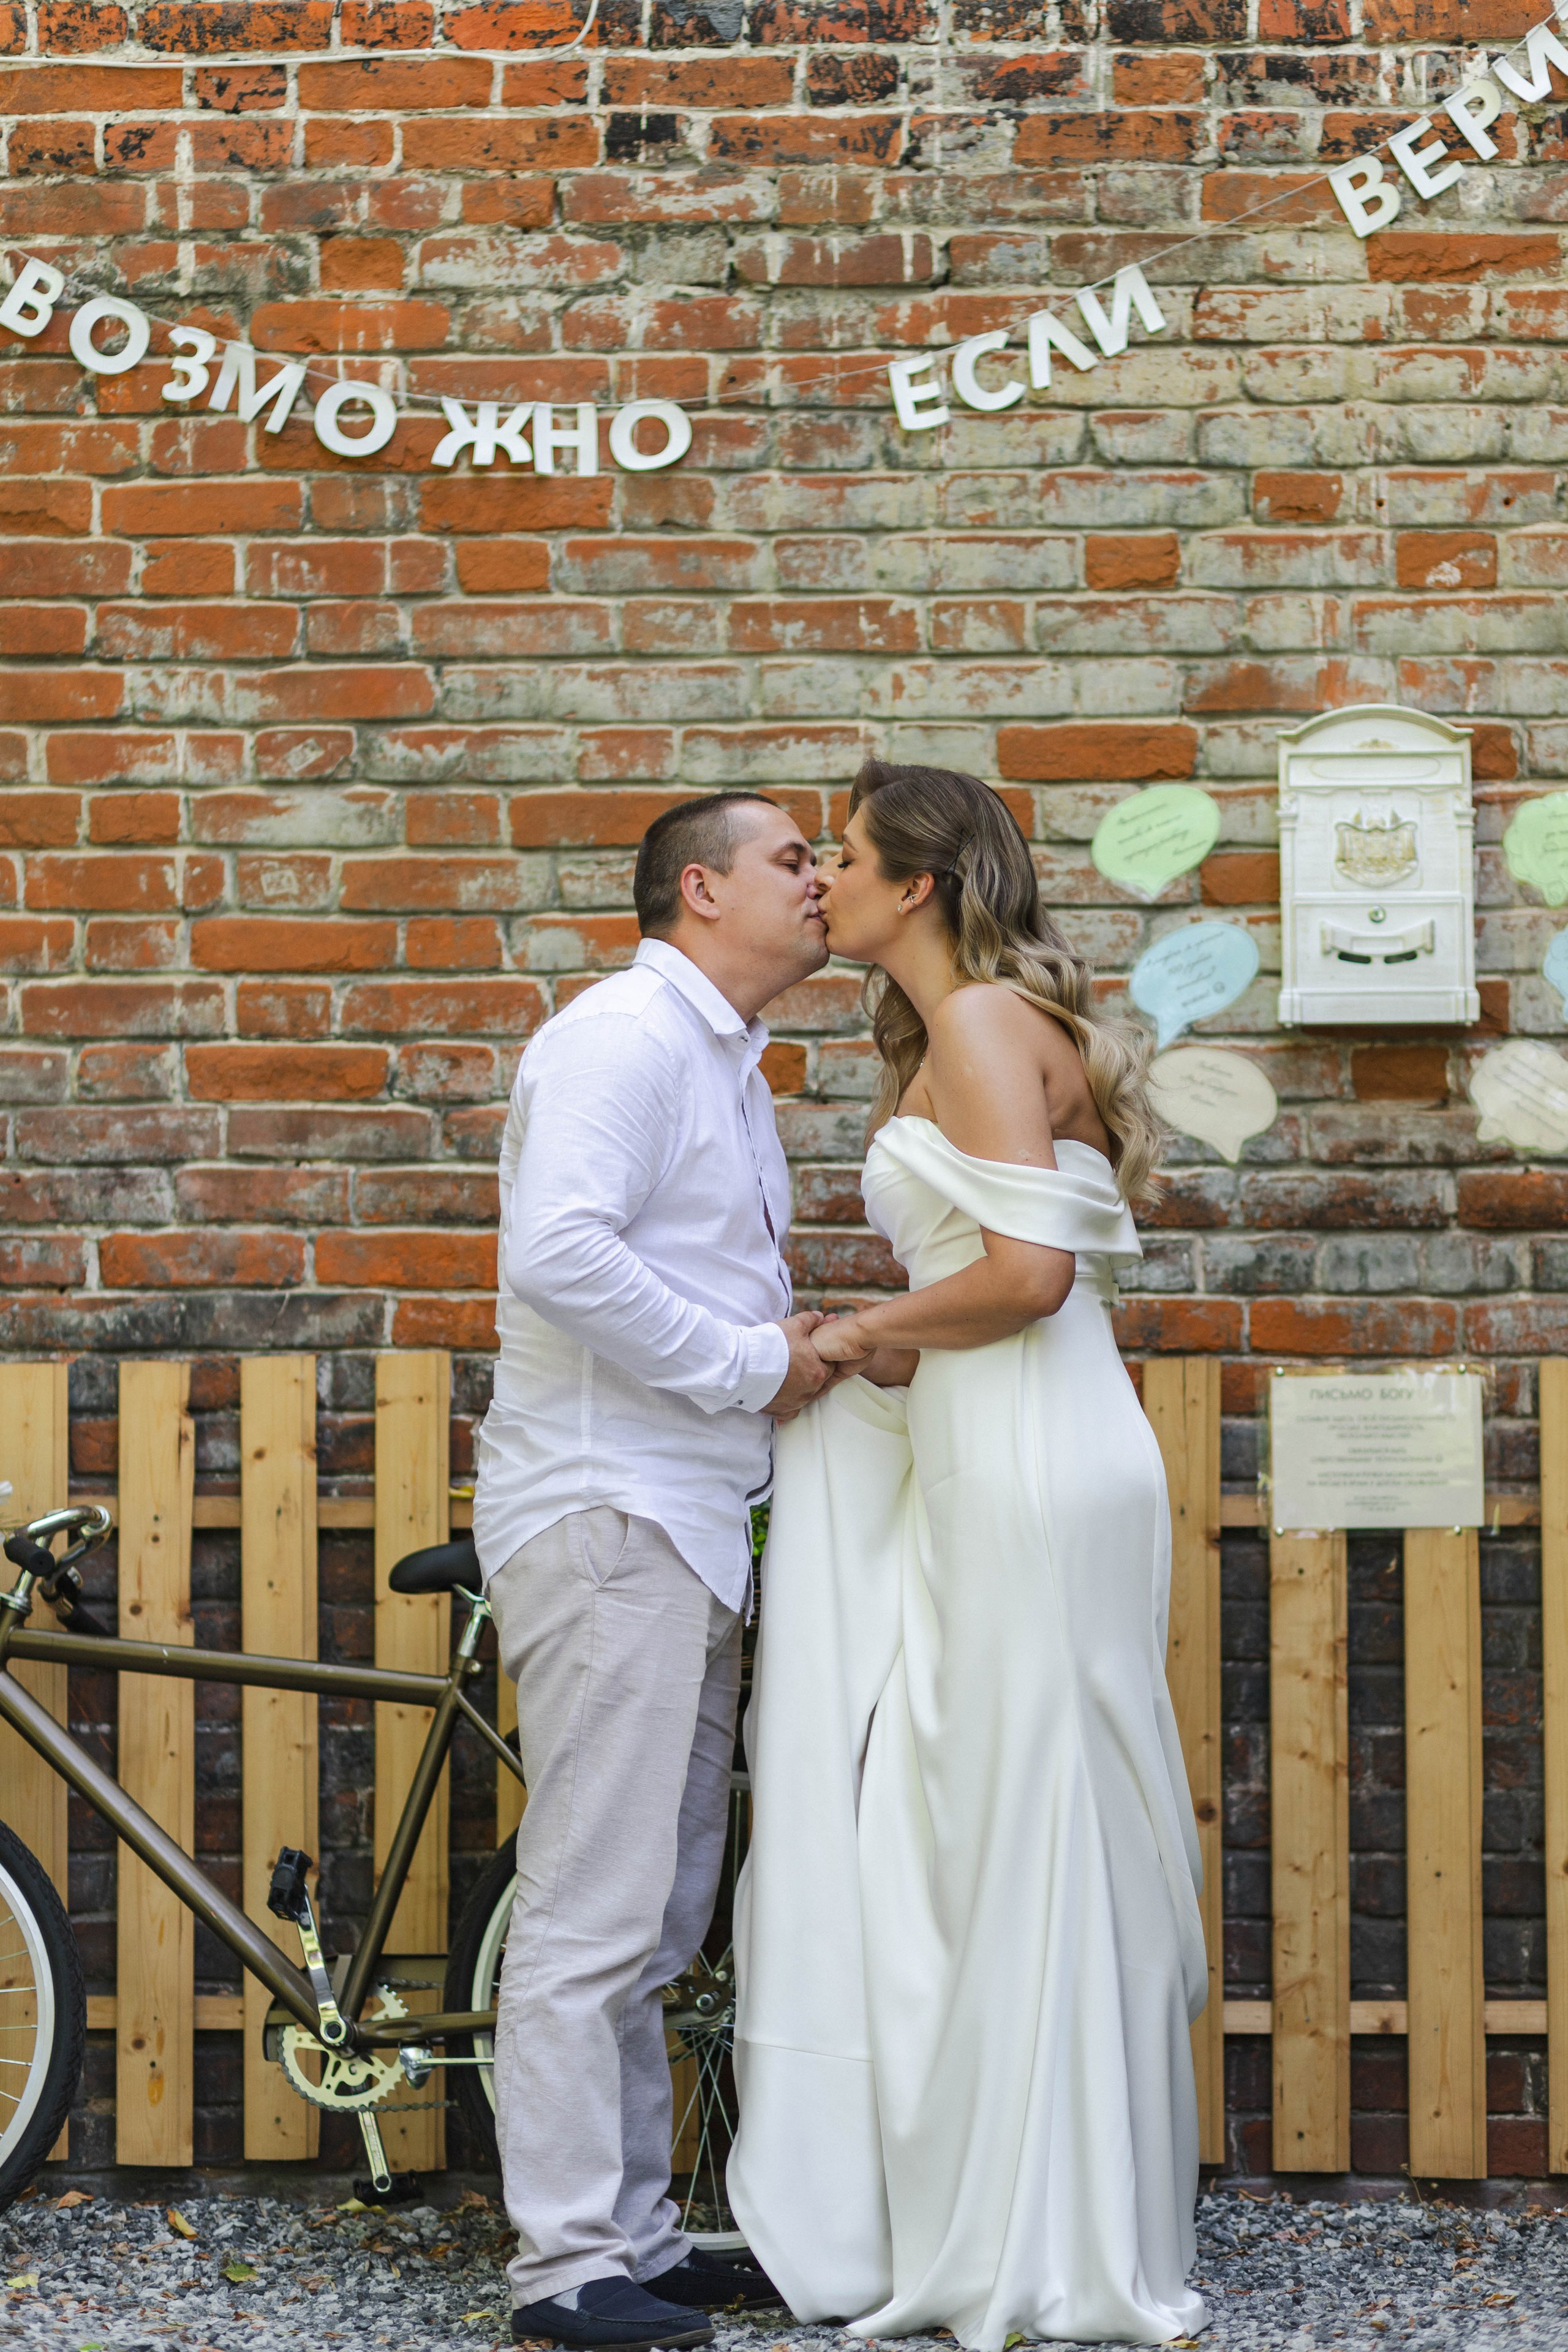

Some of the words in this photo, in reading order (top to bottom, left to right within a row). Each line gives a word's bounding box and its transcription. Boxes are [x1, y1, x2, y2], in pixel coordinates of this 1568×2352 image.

[888, 263, 1167, 431] ЕСЛИ
[1327, 0, 1568, 239] ВЕРИ
[1309, 1387, 1373, 1401] ПИСЬМО
[1379, 1387, 1415, 1401] БОГУ
